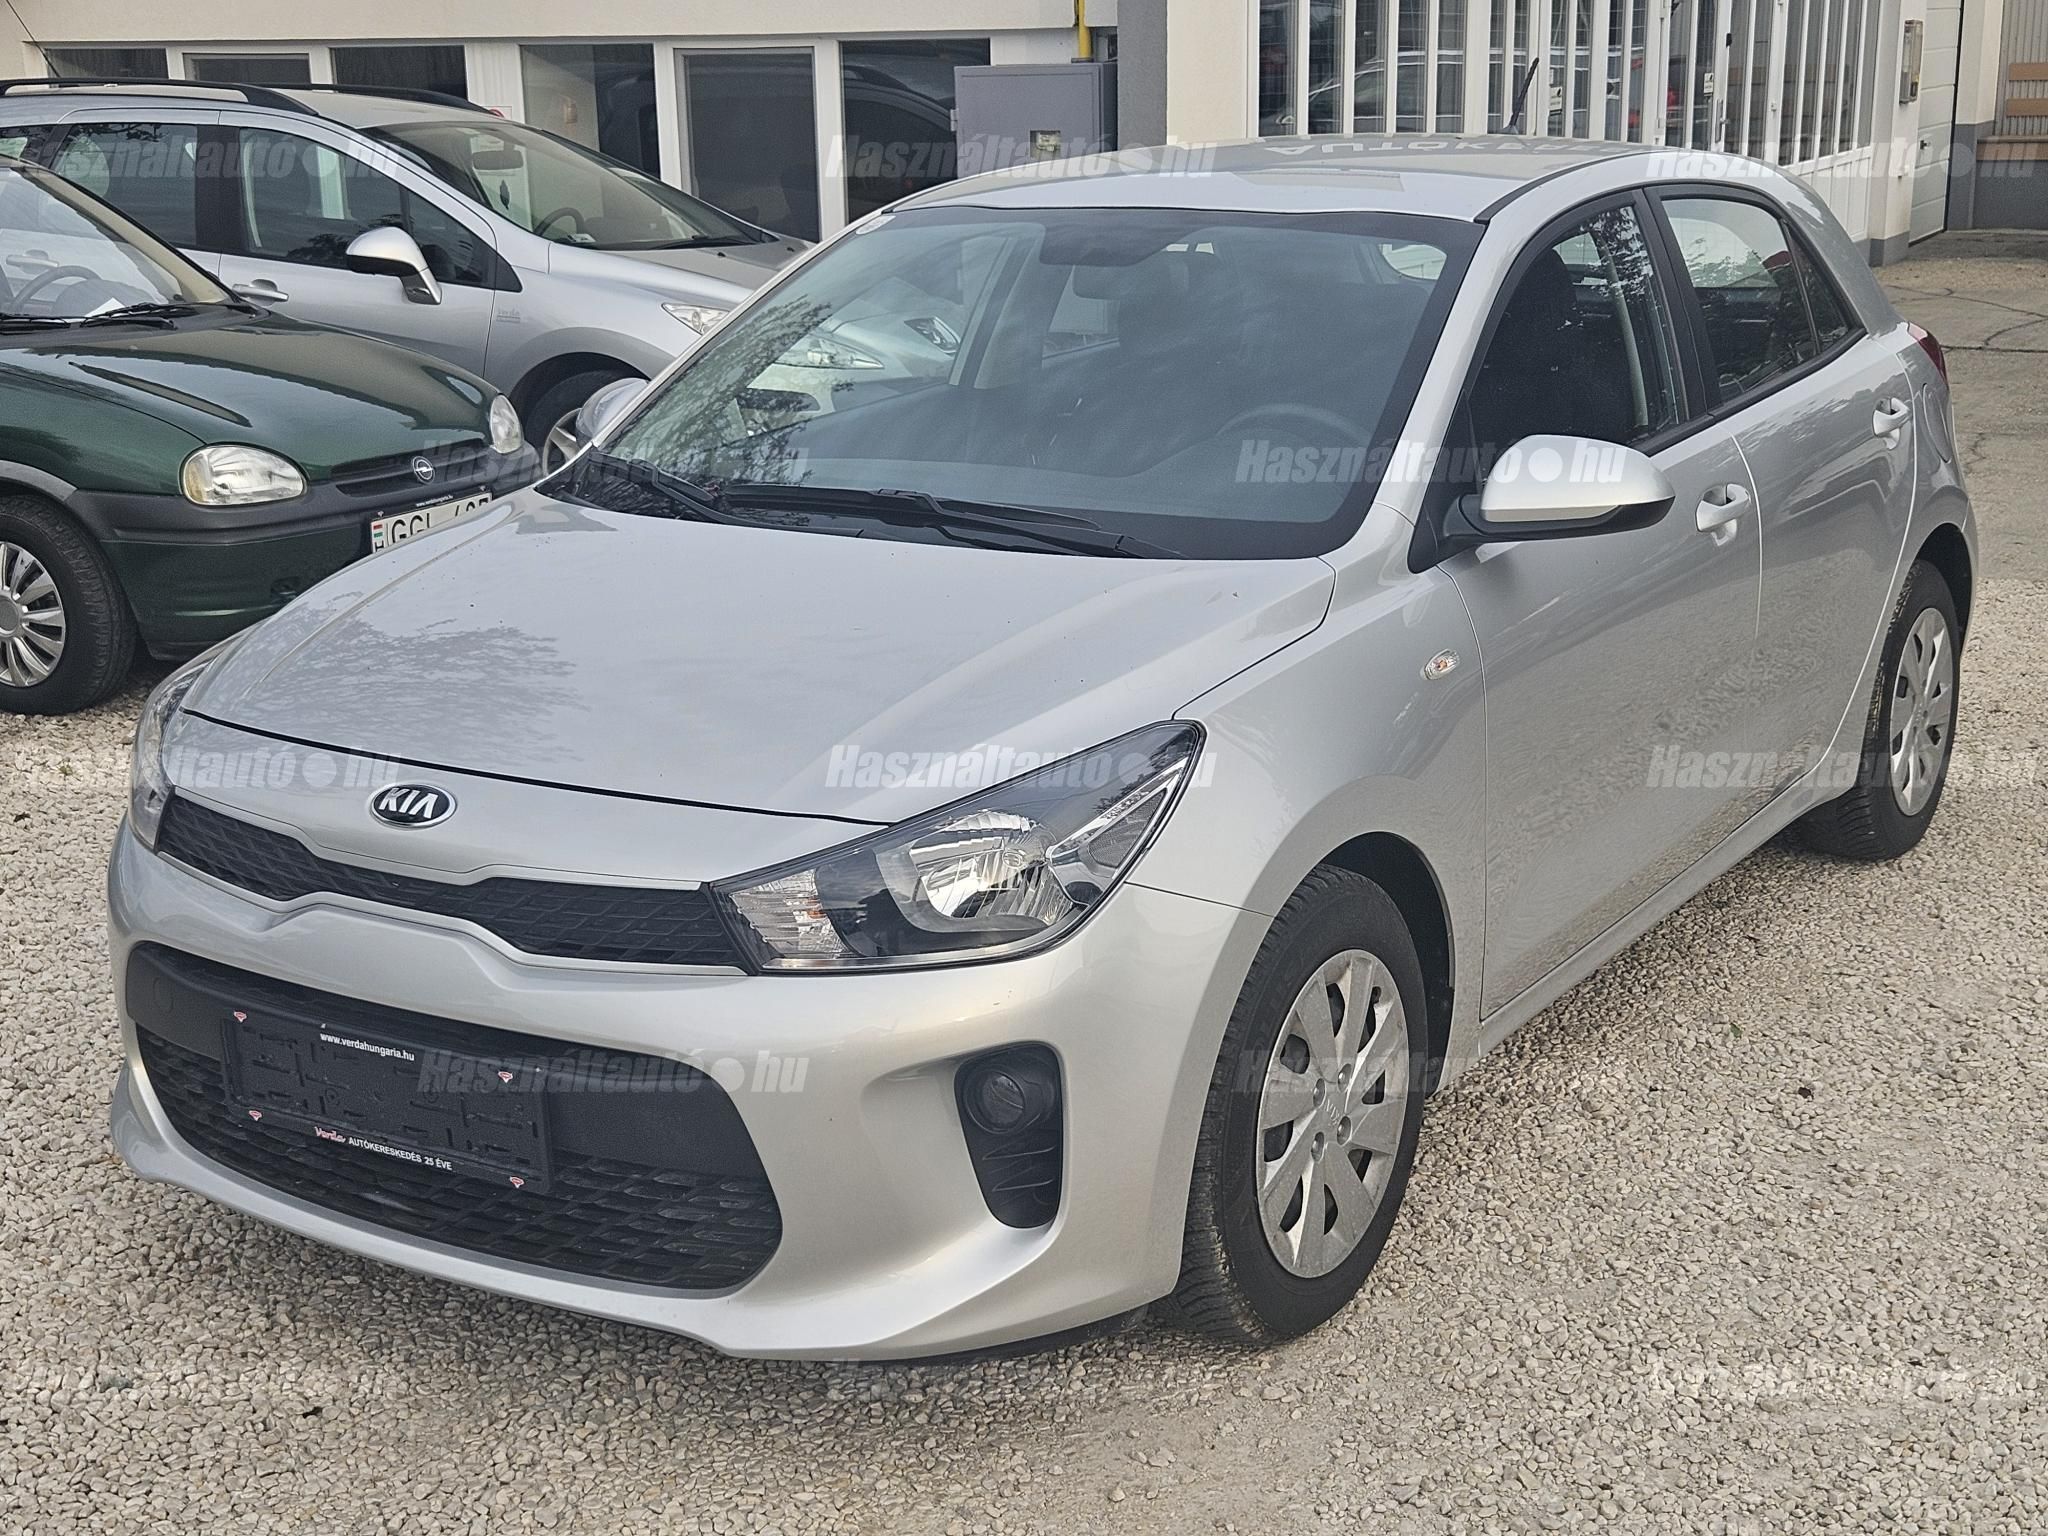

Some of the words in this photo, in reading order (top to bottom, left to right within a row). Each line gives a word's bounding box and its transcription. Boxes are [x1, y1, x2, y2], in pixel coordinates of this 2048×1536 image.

[379, 787, 439, 819] KIA
[320, 1033, 415, 1061] www.verdahungaria.hu
[348, 1136, 421, 1163] AUTÓKERESKEDÉS
[424, 1156, 434, 1166] 25
[435, 1158, 453, 1171] ÉVE
